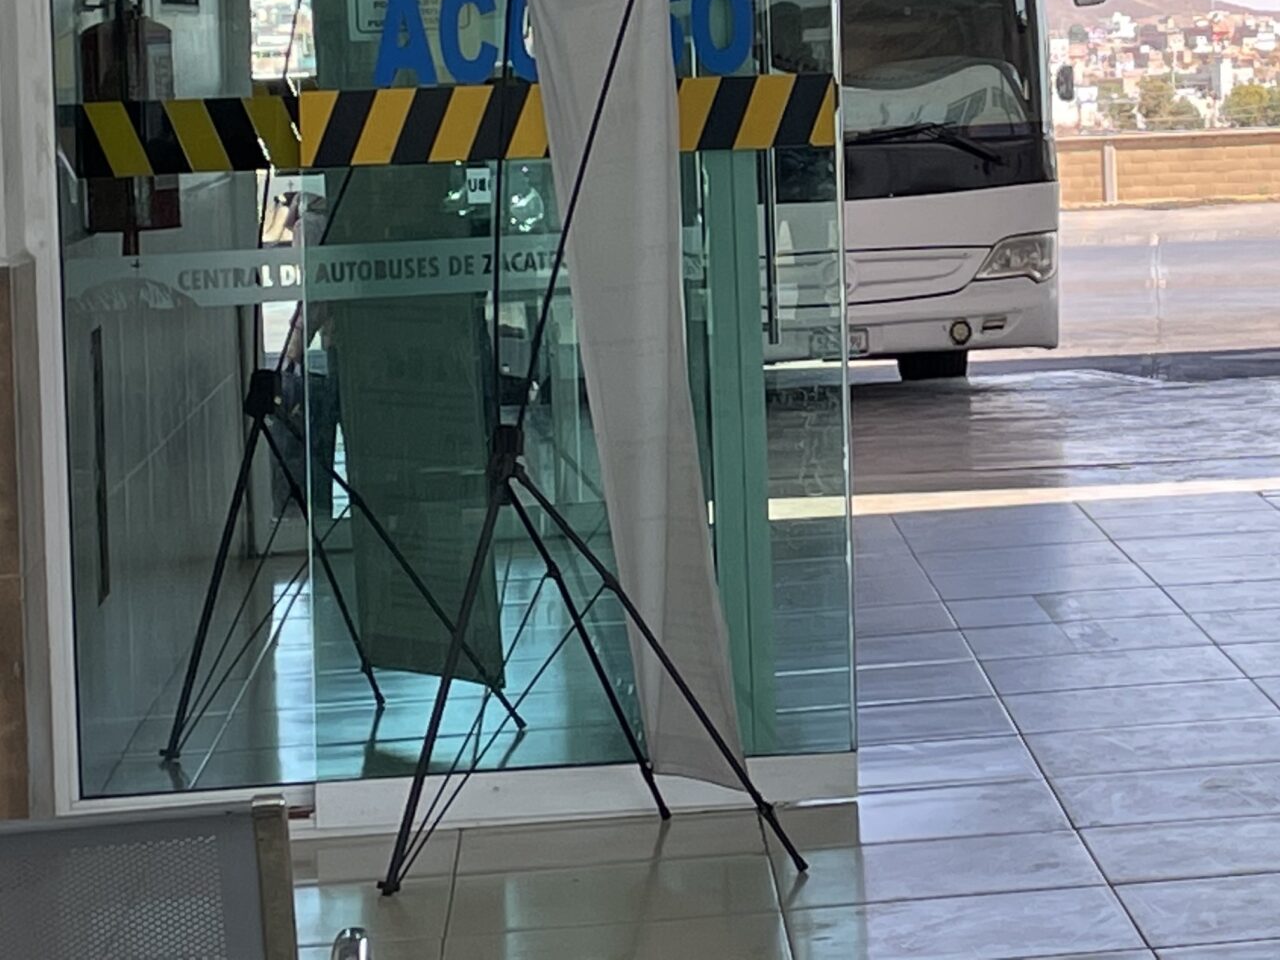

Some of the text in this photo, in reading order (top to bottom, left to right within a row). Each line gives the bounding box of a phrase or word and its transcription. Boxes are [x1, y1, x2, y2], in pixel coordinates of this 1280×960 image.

[177, 264, 274, 292] CENTRAL
[315, 255, 440, 285] AUTOBUSES
[448, 253, 475, 277] DE
